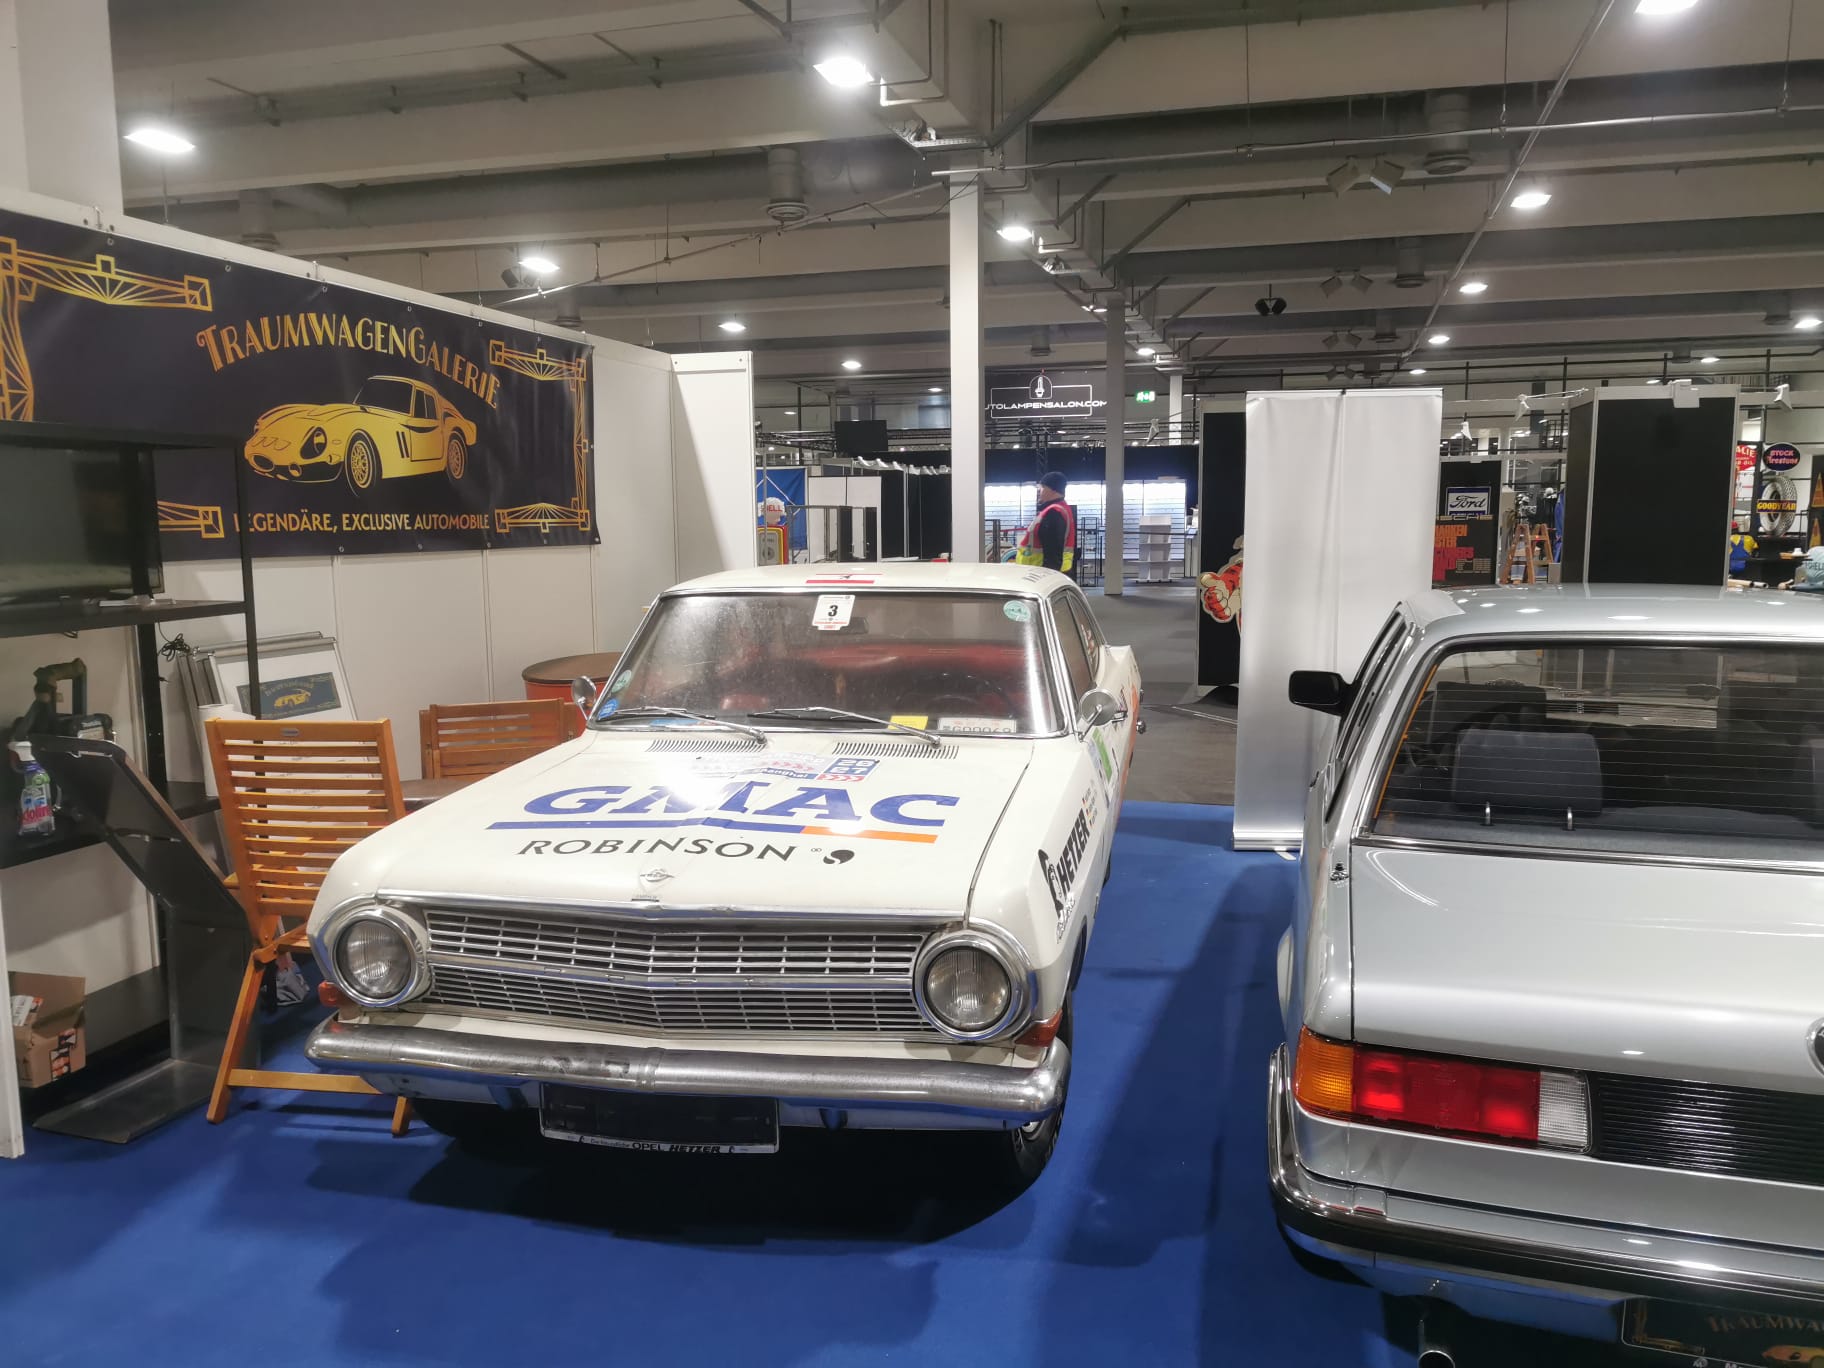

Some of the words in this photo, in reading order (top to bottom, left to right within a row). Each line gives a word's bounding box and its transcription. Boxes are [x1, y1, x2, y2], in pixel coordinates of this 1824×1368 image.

[1449, 494, 1486, 509] Ford
[1757, 502, 1796, 511] GOODYEAR
[233, 508, 338, 533] LGENDÄRE,
[342, 513, 412, 531] EXCLUSIVE
[414, 514, 490, 531] AUTOMOBILE
[828, 604, 839, 617] 3
[523, 780, 960, 827] GMAC
[517, 837, 797, 862] ROBINSON
[1056, 807, 1090, 900] HETZER
[632, 1142, 664, 1151] OPEL
